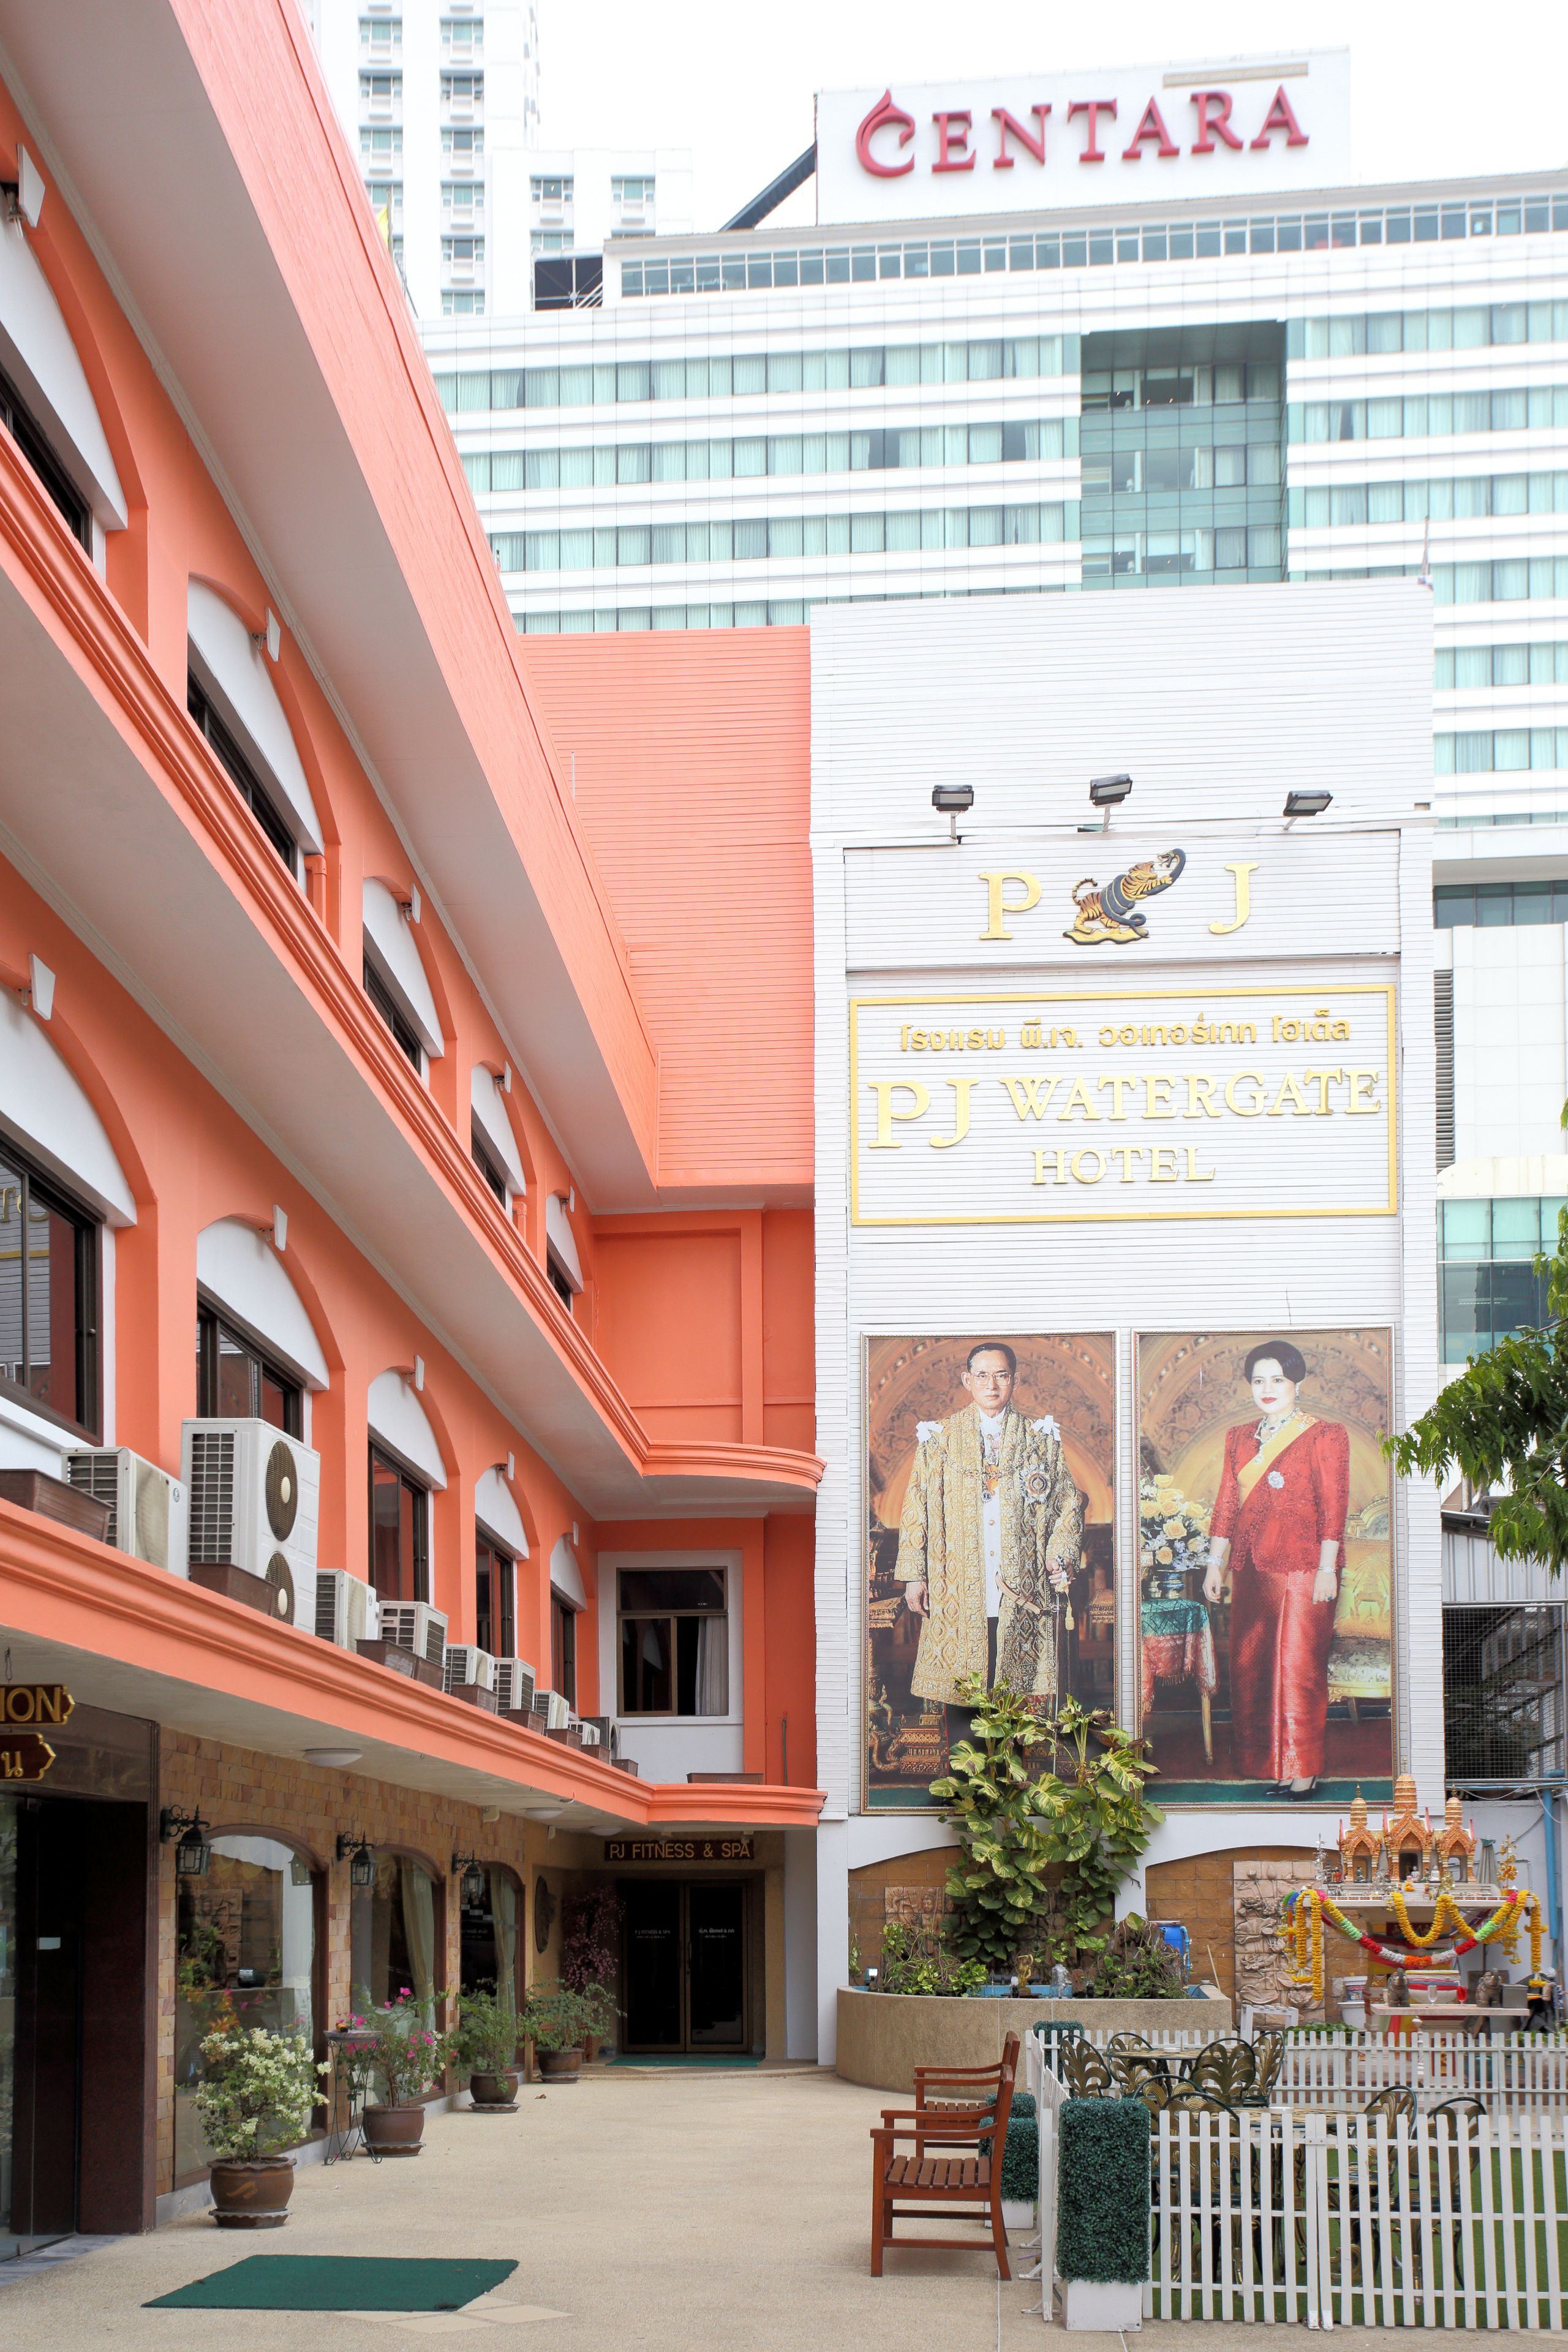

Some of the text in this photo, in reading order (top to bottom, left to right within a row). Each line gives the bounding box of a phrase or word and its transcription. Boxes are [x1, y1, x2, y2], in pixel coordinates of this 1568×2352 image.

[856, 85, 1309, 178] CENTARA
[979, 862, 1259, 940] P J
[901, 1008, 1351, 1051] โรงแรม พี.เจ. วอเทอร์เกท โฮเต็ล
[868, 1068, 1381, 1148] PJ WATERGATE
[1032, 1147, 1216, 1185] HOTEL
[609, 1842, 750, 1858] PJ FITNESS & SPA
